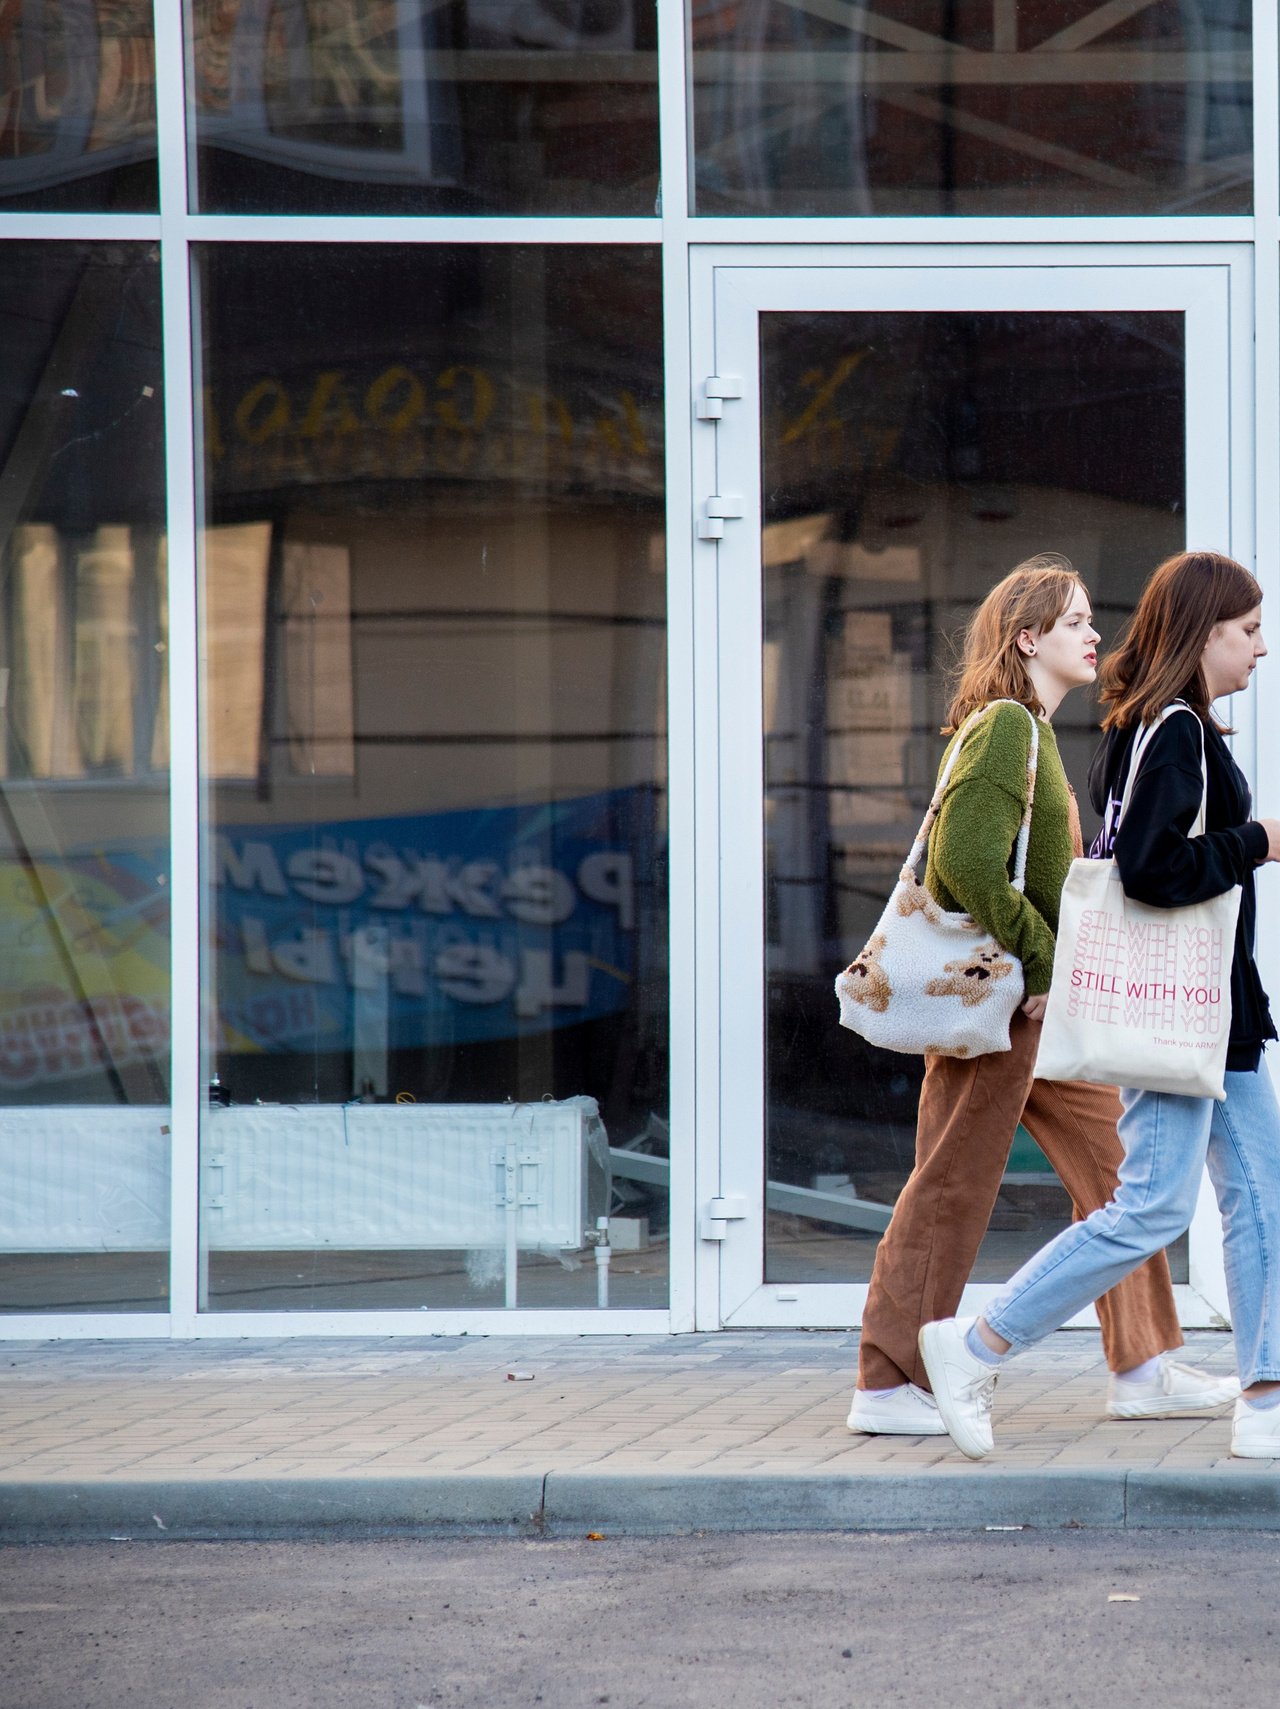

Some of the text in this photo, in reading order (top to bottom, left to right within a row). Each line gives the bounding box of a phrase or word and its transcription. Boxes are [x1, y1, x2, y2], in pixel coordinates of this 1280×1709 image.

[1070, 969, 1221, 1005] STILL WITH YOU
[1153, 1036, 1219, 1050] Thank you ARMY
